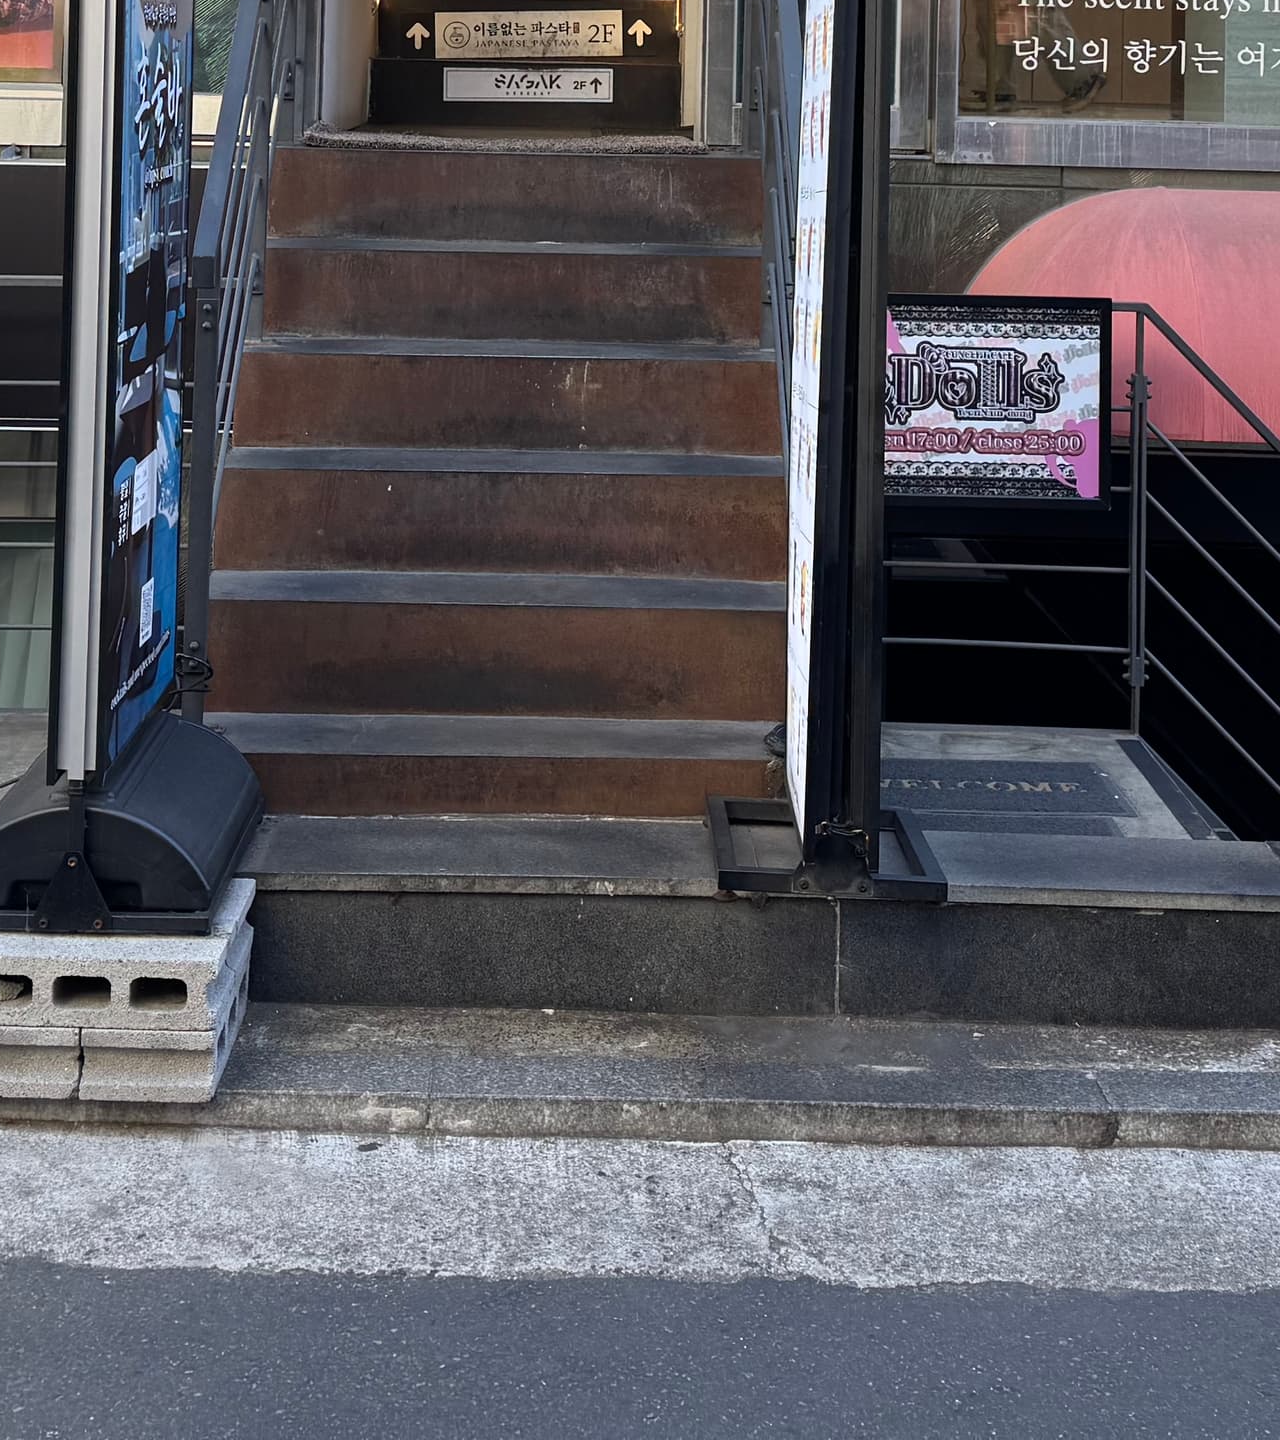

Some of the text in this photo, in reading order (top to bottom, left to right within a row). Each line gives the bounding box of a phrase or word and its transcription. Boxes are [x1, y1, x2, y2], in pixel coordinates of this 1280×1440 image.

[473, 19, 617, 45] 이름없는 파스타 2F
[474, 38, 580, 48] JAPANESE PASTAYA
[1013, 36, 1111, 74] 당신의
[1122, 38, 1225, 76] 향기는
[493, 73, 587, 91] SAGAK 2F
[891, 353, 1062, 410] Dolls
[908, 432, 960, 448] 17:00
[977, 433, 1023, 449] close
[1023, 434, 1082, 451] 25:00
